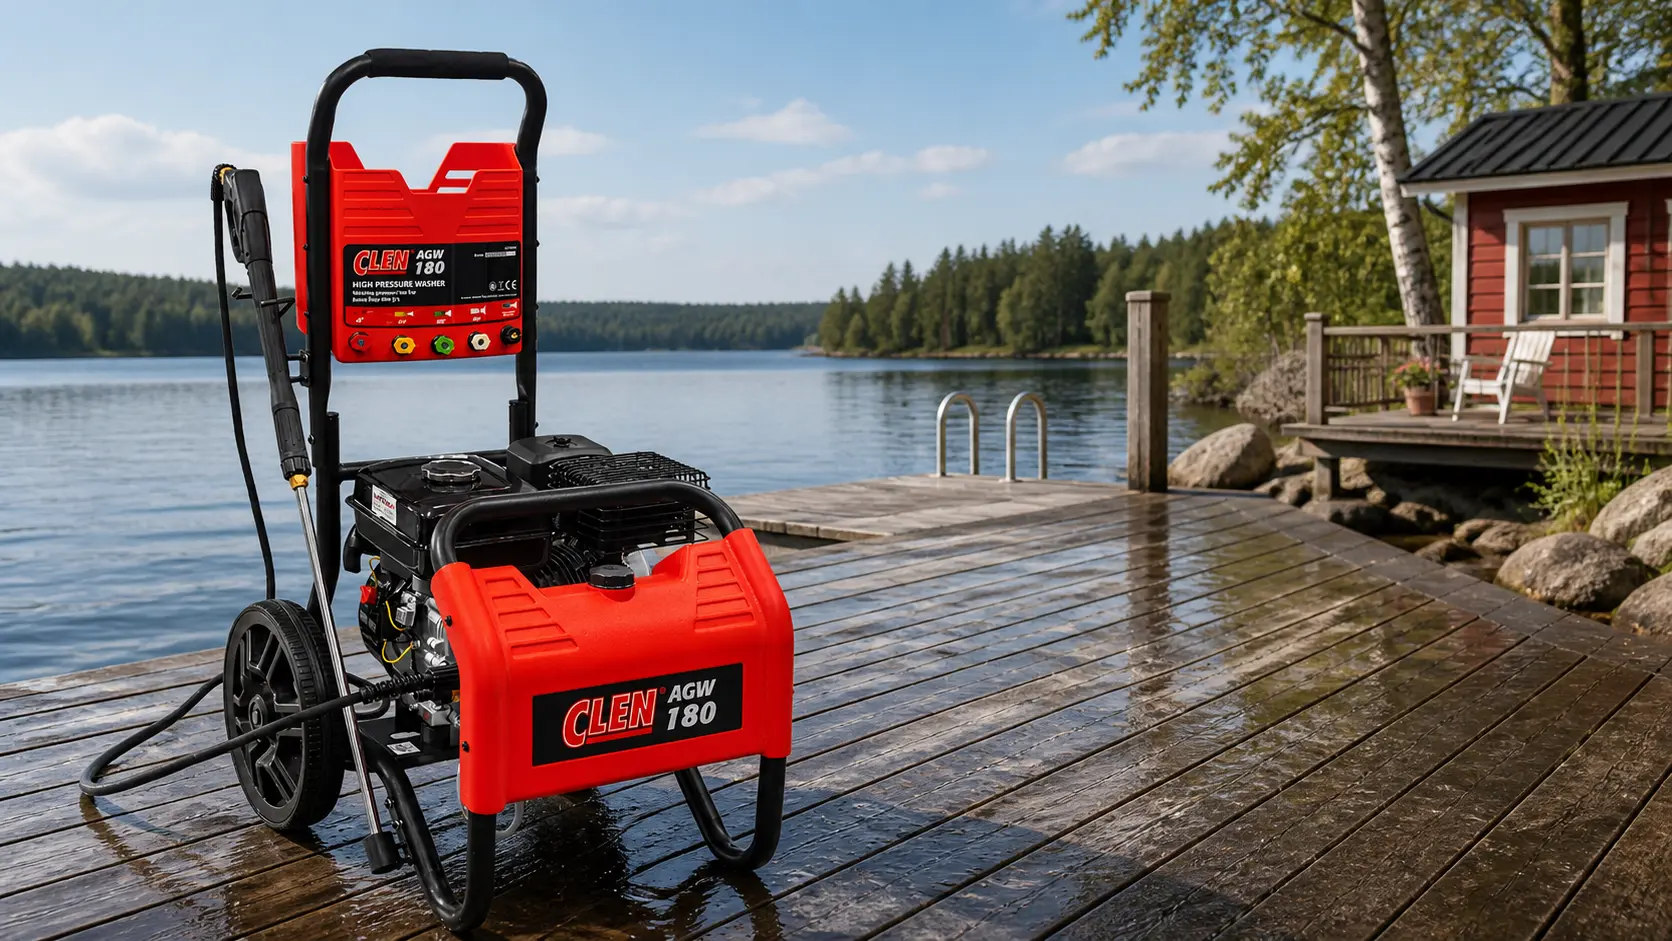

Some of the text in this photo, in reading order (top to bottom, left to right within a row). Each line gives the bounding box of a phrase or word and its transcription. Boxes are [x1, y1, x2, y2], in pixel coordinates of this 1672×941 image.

[353, 250, 409, 276] CLEN
[416, 249, 444, 259] AGW
[416, 261, 445, 275] 180
[415, 280, 445, 288] WASHER
[667, 679, 716, 703] AGW
[562, 688, 657, 748] CLEN
[667, 701, 717, 731] 180
